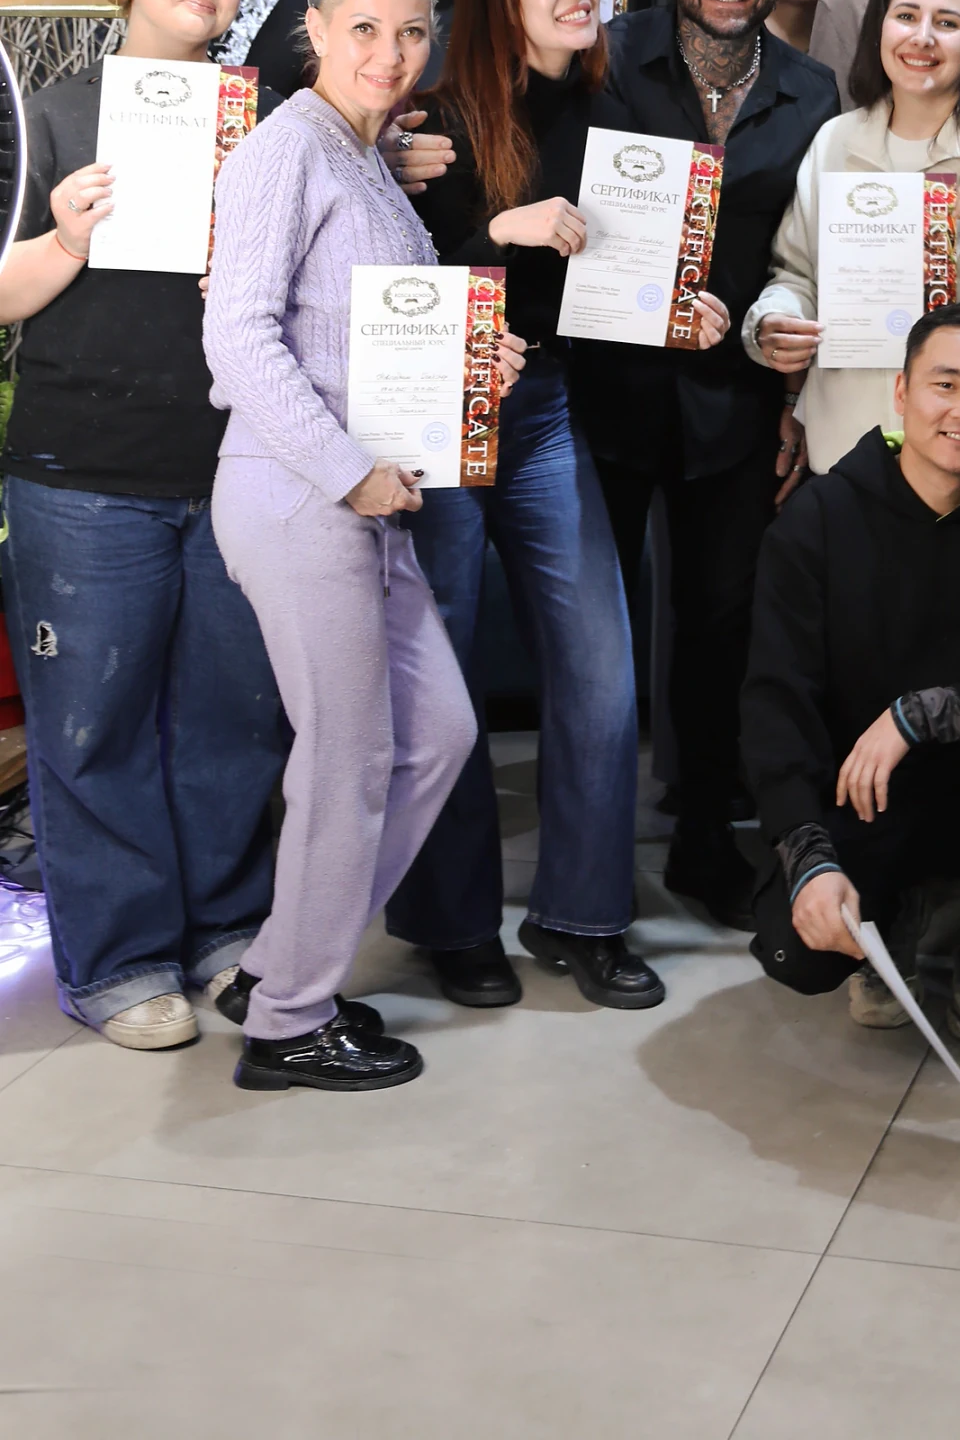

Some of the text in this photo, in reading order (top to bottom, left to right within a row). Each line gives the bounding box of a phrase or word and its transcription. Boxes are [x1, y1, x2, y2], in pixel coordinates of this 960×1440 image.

[109, 111, 209, 129] СЕРТИФИКАТ
[590, 183, 680, 205] СЕРТИФИКАТ
[828, 223, 917, 234] СЕРТИФИКАТ
[672, 154, 715, 340] CERTIFICATE
[360, 324, 459, 336] СЕРТИФИКАТ
[466, 277, 496, 477] CERTIFICATE
